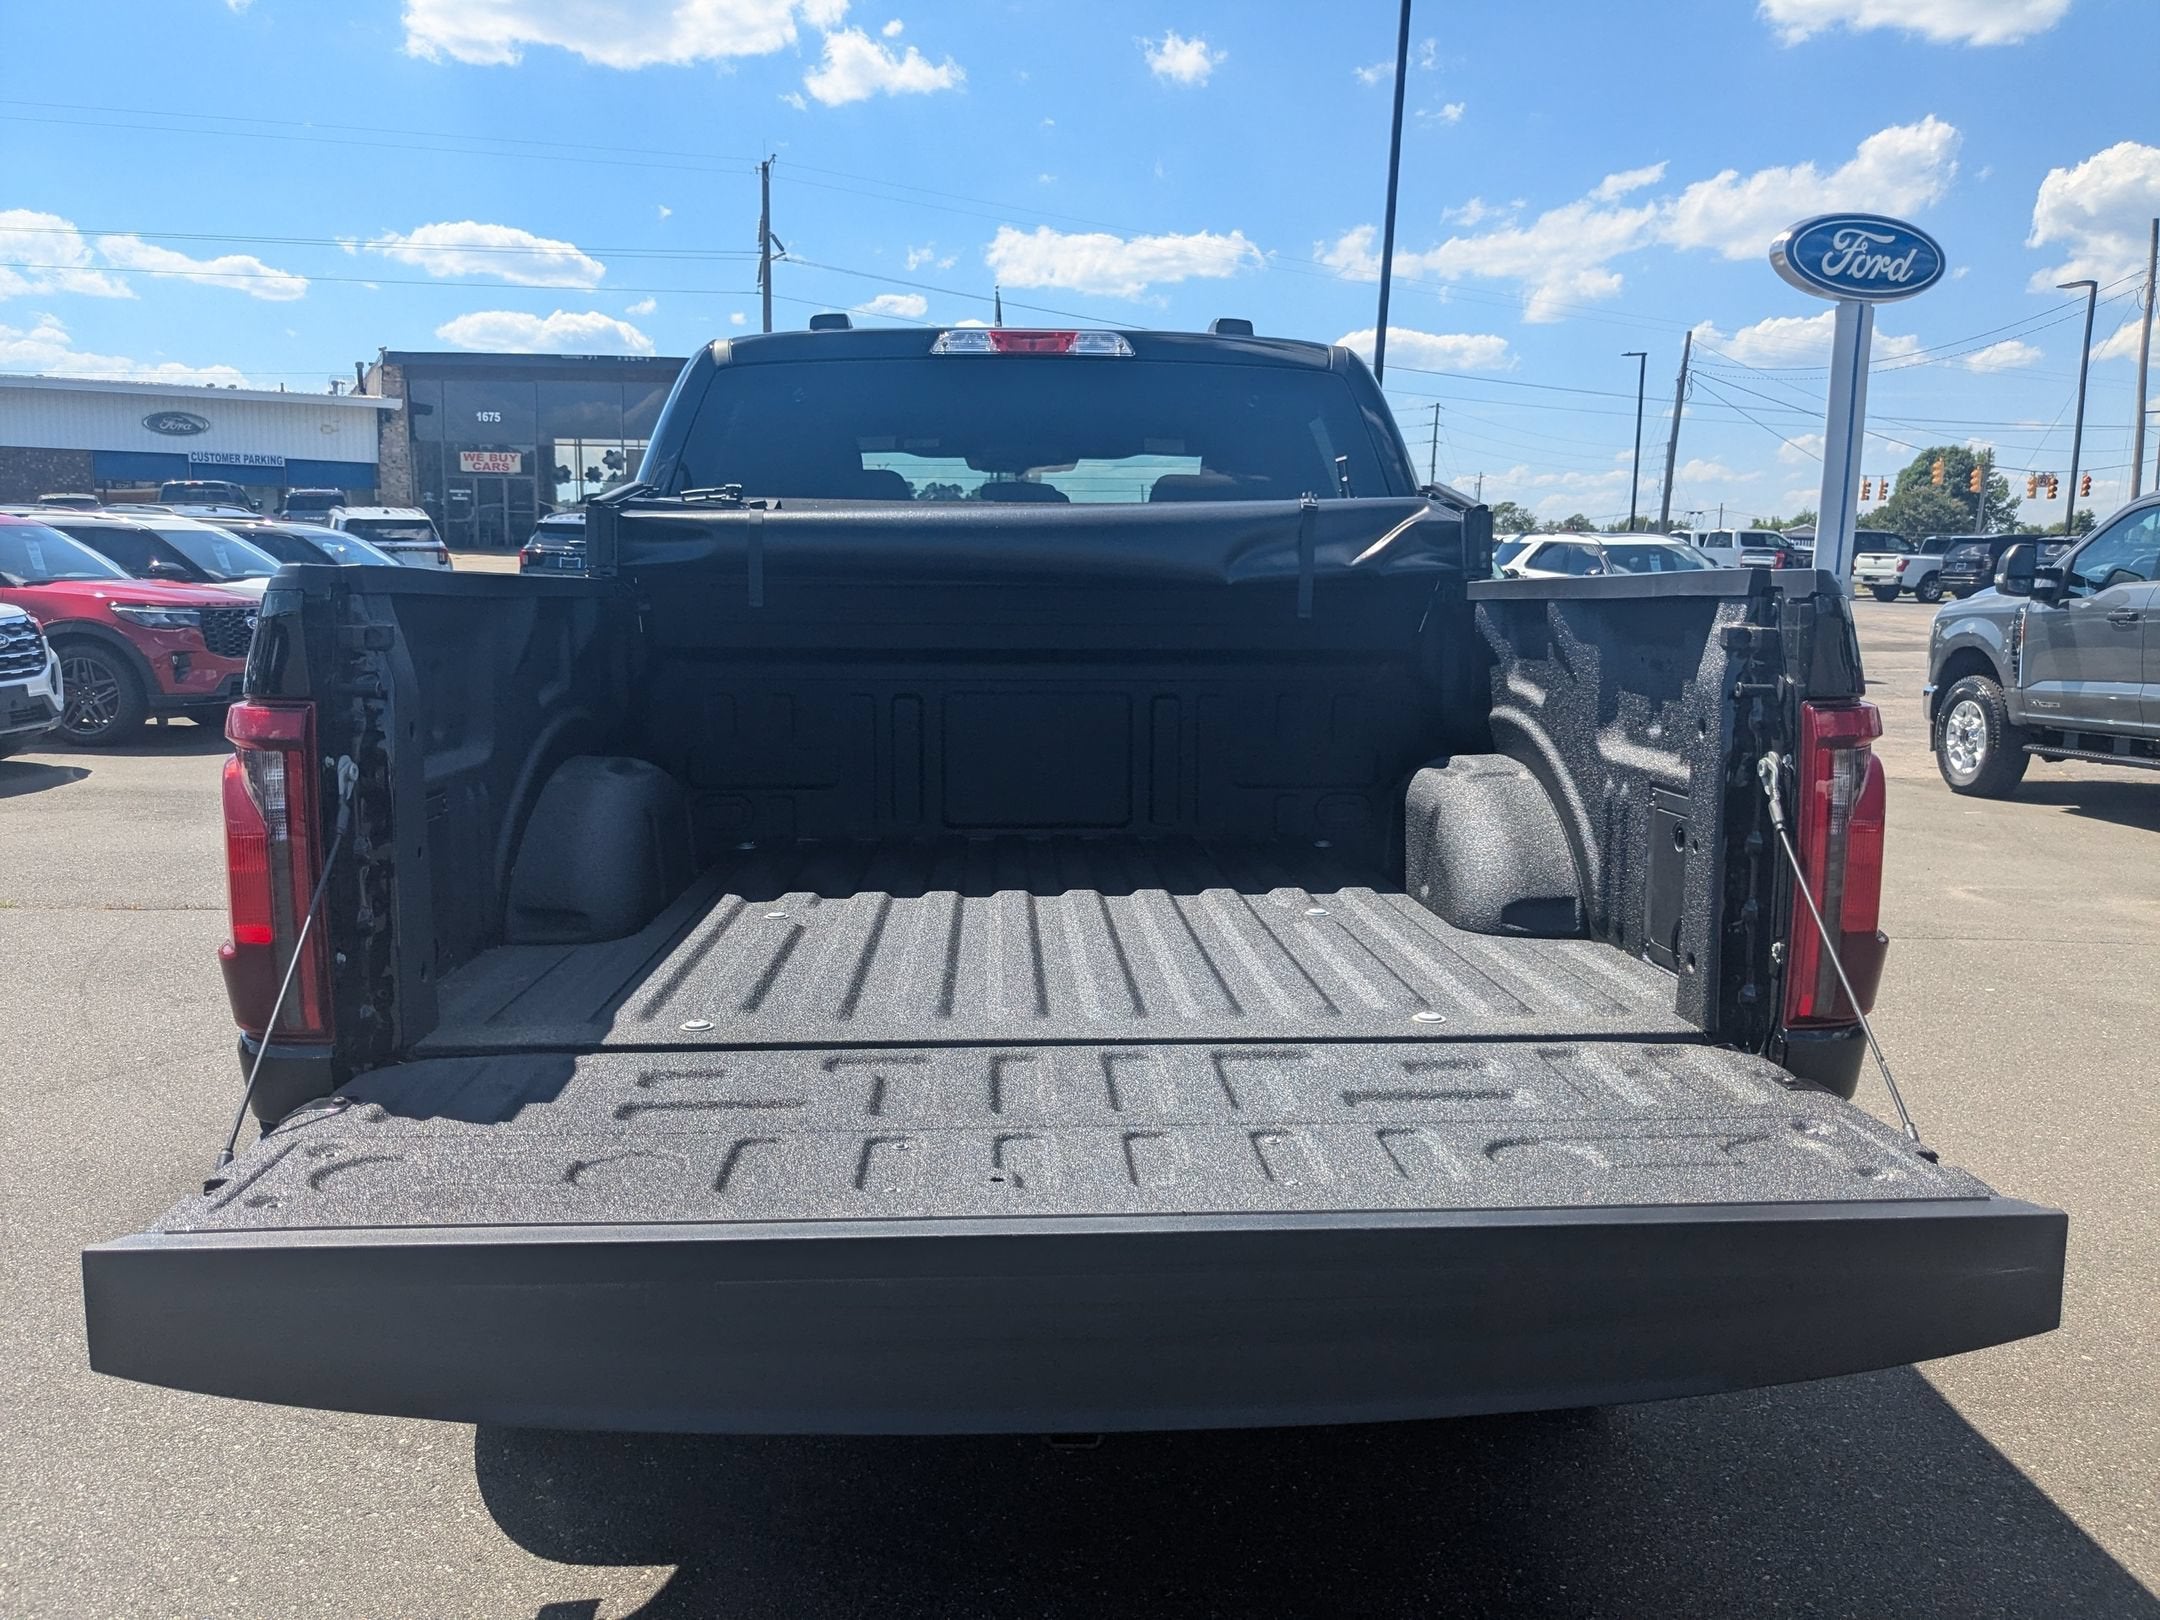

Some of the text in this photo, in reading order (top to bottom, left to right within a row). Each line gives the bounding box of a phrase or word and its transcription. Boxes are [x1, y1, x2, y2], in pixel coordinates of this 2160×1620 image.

[1821, 228, 1918, 282] Ford
[476, 411, 501, 422] 1675
[191, 452, 283, 465] CUSTOMER PARKING
[463, 453, 518, 462] WE BUY
[472, 462, 510, 471] CARS
